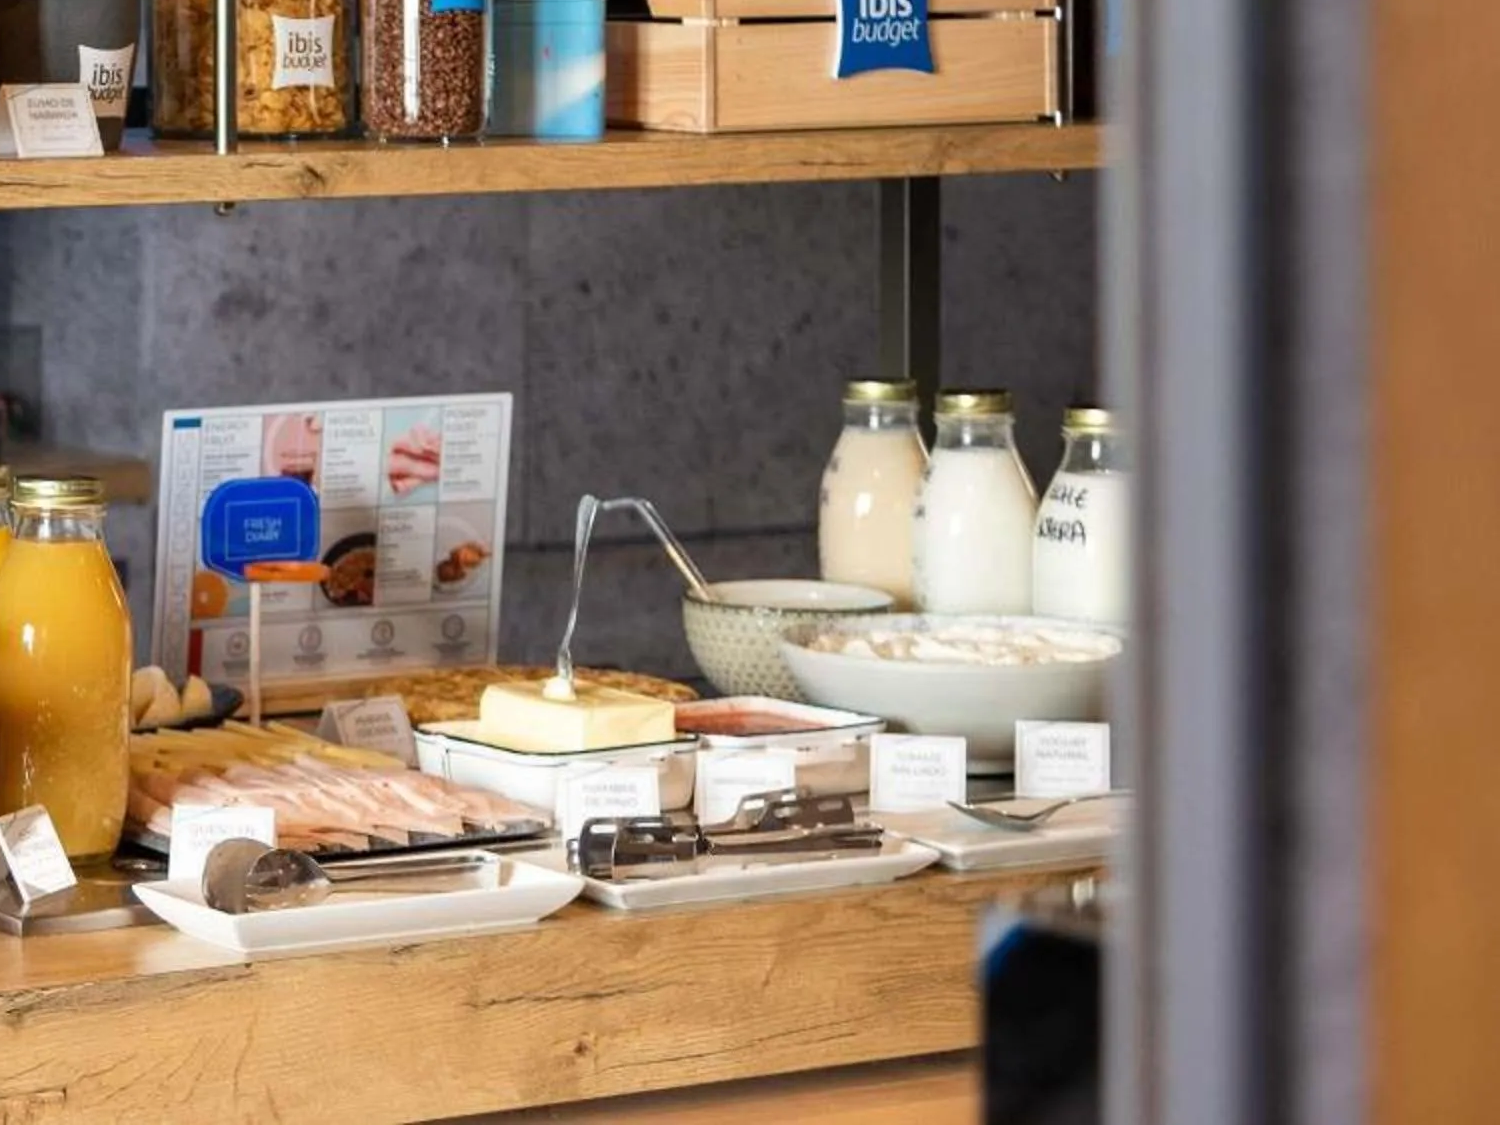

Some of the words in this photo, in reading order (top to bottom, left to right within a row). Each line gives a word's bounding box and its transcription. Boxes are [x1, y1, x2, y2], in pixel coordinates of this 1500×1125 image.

[288, 32, 323, 55] ibis
[852, 17, 920, 48] budget
[282, 52, 328, 71] budget
[92, 62, 124, 86] ibis
[244, 517, 282, 530] FRESH
